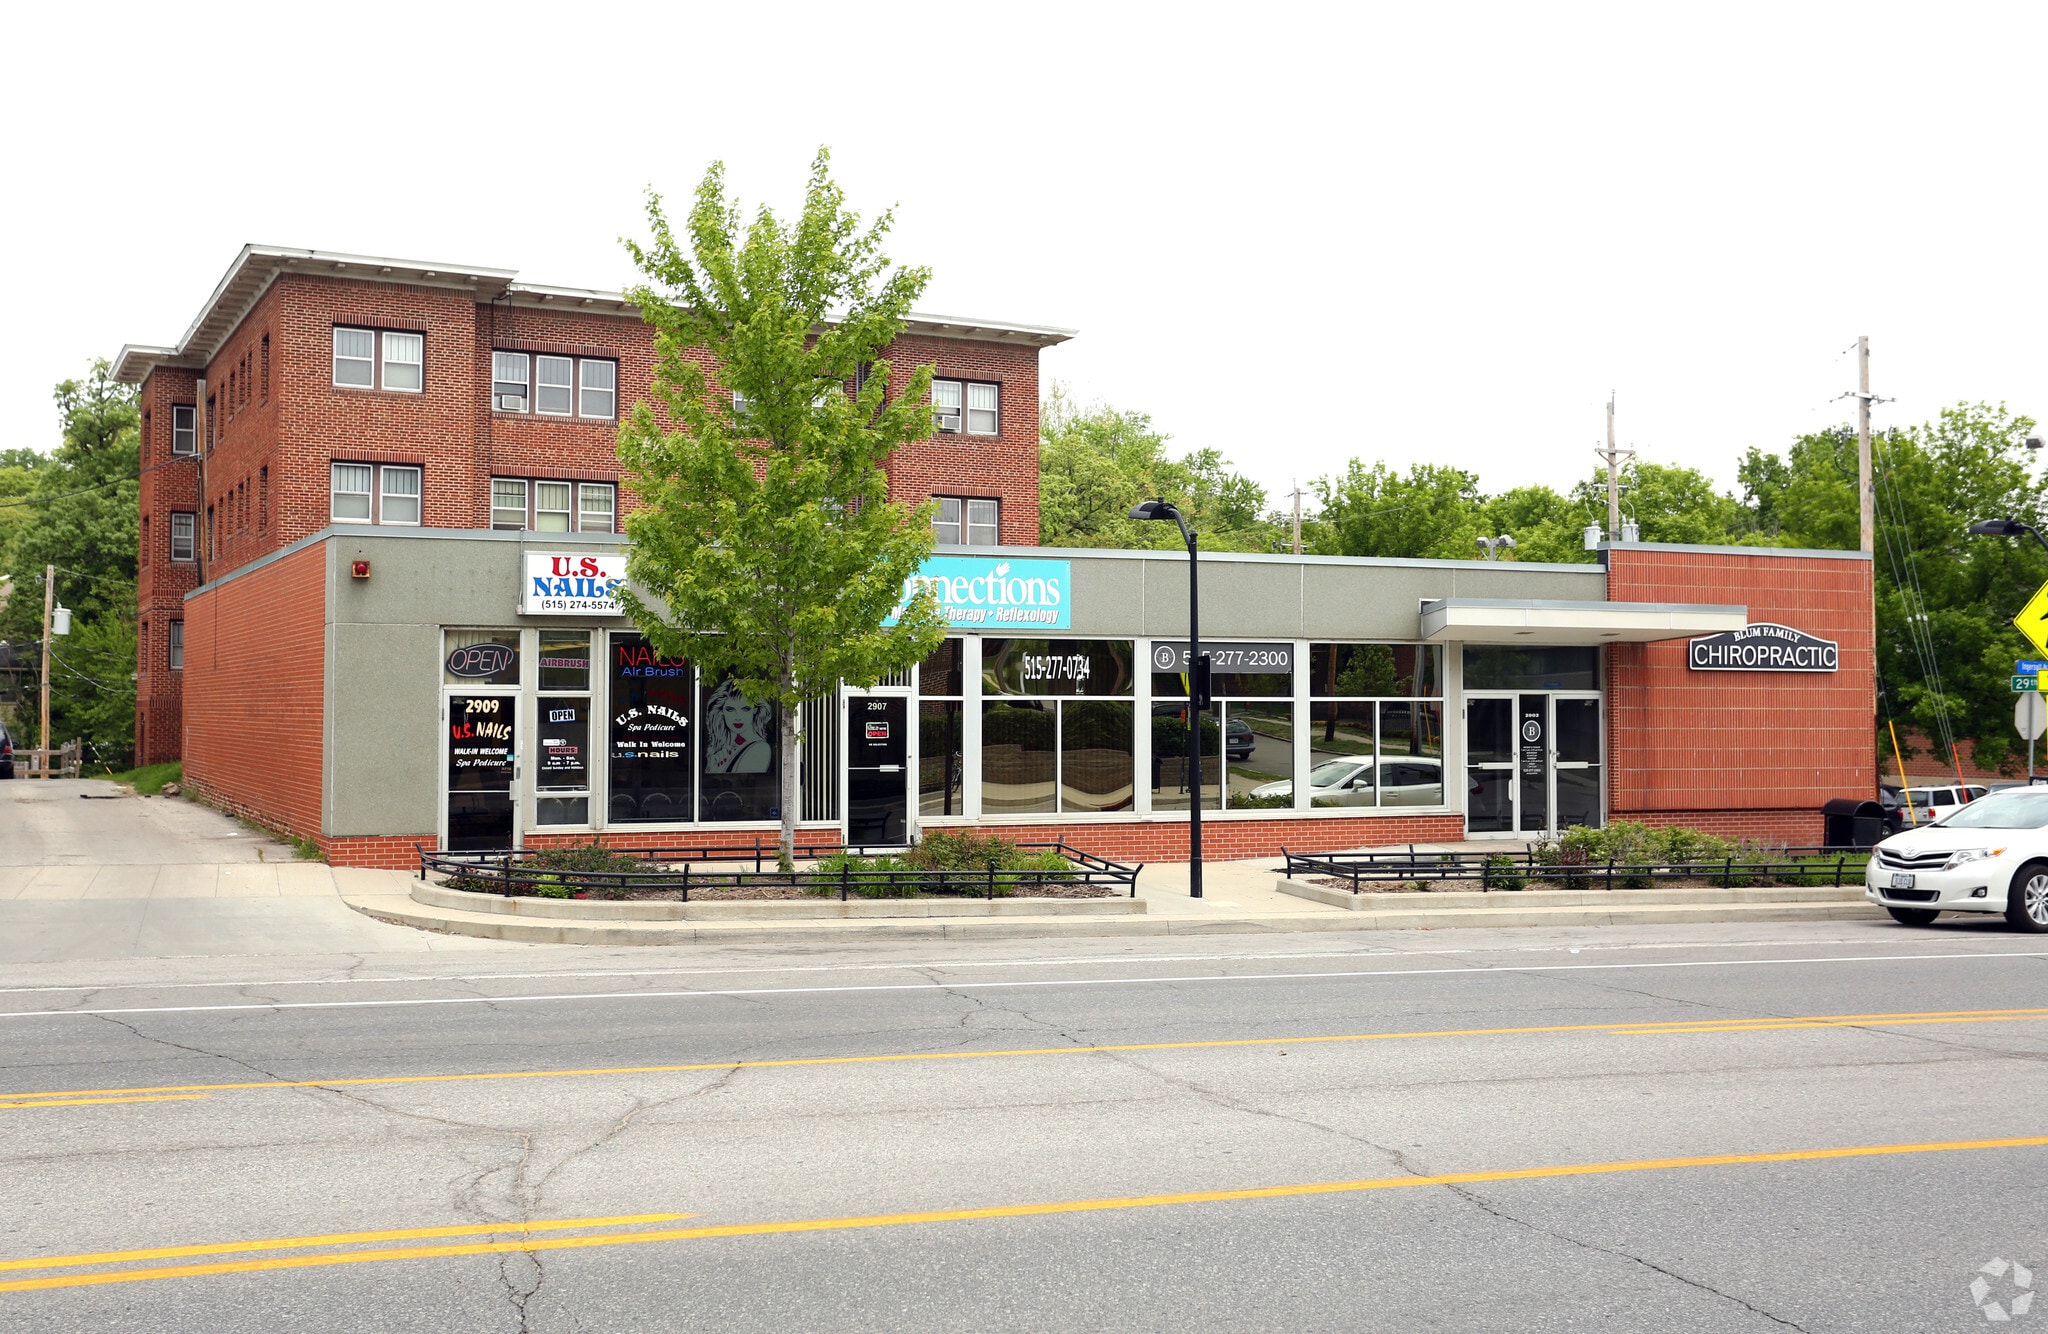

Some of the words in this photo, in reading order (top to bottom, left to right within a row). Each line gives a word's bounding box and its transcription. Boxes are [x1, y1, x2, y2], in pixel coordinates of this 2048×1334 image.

[551, 556, 606, 578] U.S.
[541, 600, 566, 610] (515)
[570, 600, 615, 610] 274-5574
[996, 607, 1059, 624] Reflexology
[1733, 627, 1761, 642] BLUM
[1763, 627, 1800, 643] FAMILY
[450, 649, 509, 670] OPEN
[540, 658, 590, 669] AIRBRUSH
[1694, 645, 1836, 667] CHIROPRACTIC
[645, 667, 684, 676] Brush
[1024, 656, 1090, 680] 515-277-0734
[465, 699, 499, 713] 2909
[867, 702, 887, 710] 2907
[551, 710, 574, 721] OPEN
[615, 708, 643, 726] U.S.
[646, 705, 689, 727] NAILS
[452, 722, 475, 739] U.S.
[476, 721, 512, 740] NAILS
[627, 724, 642, 732] Spa
[456, 758, 471, 768] Spa
[473, 758, 507, 767] Pedicure
